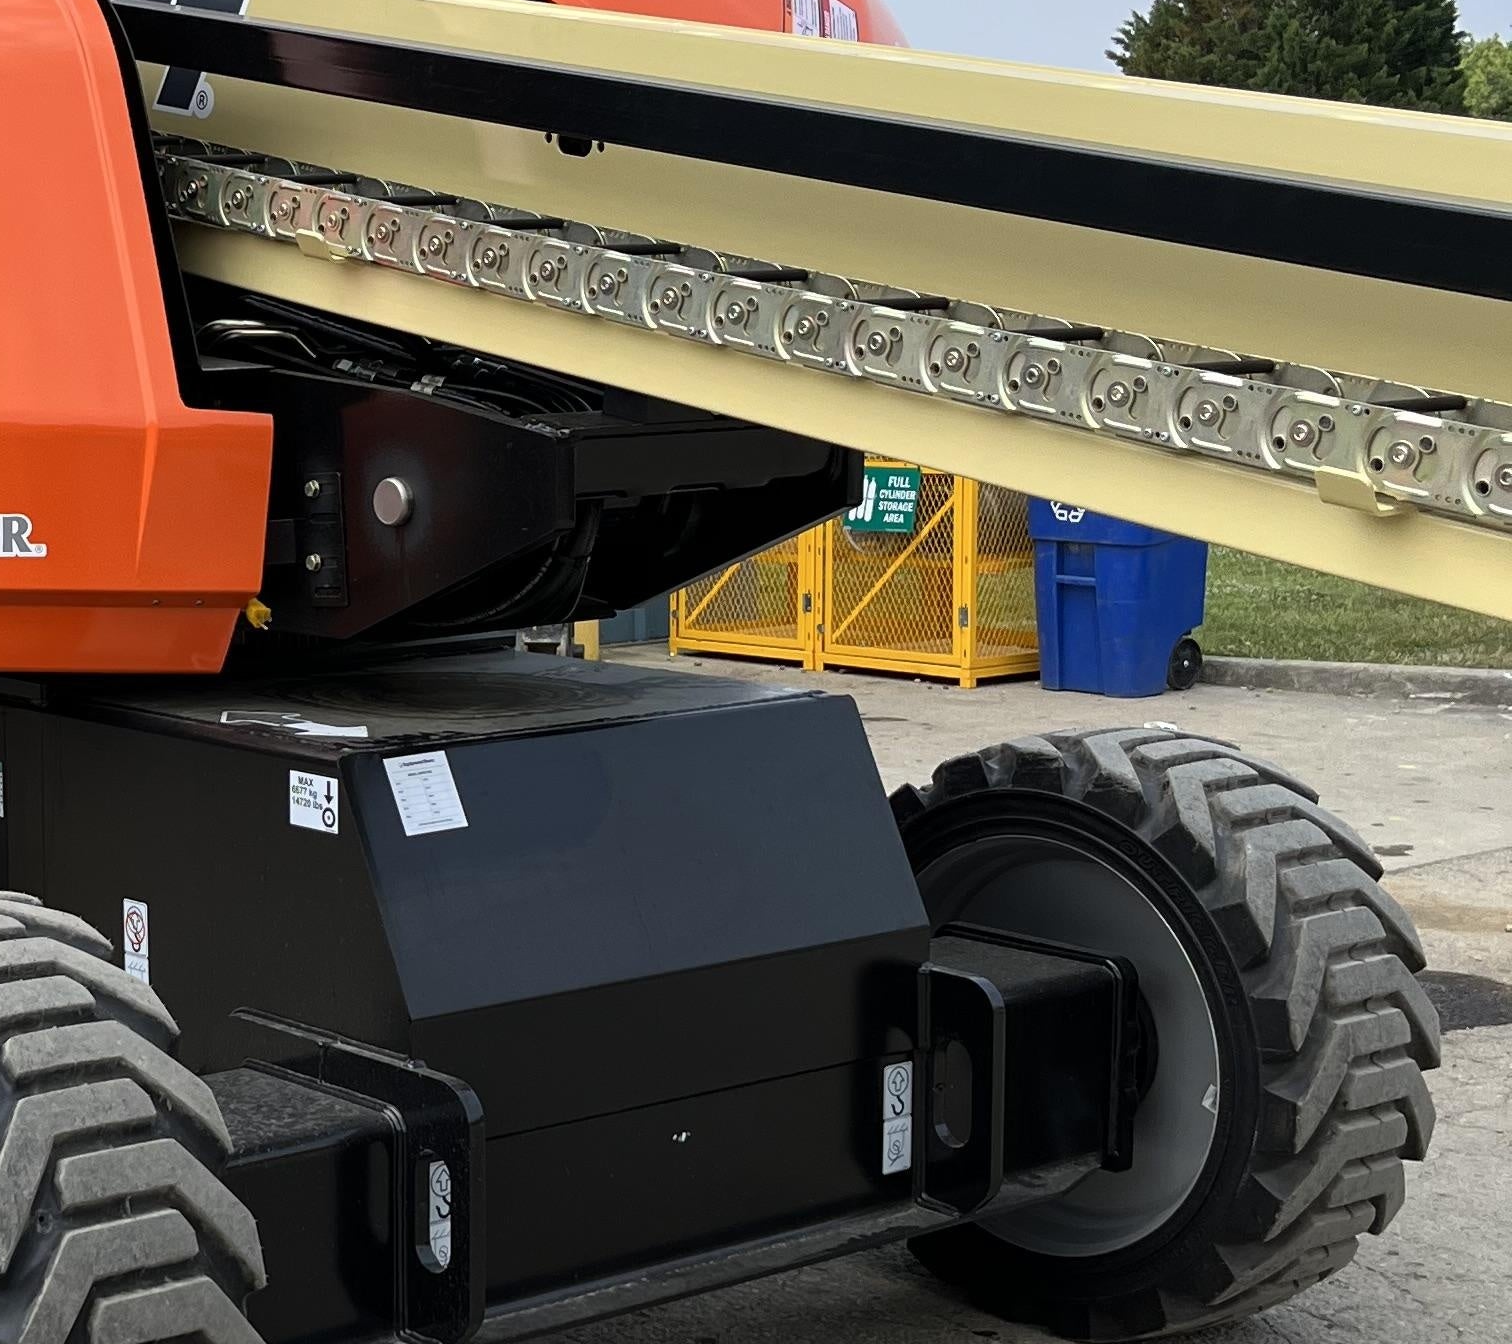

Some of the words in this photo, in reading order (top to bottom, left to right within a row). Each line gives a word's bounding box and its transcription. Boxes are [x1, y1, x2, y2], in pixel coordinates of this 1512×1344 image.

[888, 476, 911, 488] FULL
[879, 489, 916, 500] CYLINDER
[878, 500, 914, 512] STORAGE
[883, 513, 904, 523] AREA
[298, 776, 314, 787] MAX
